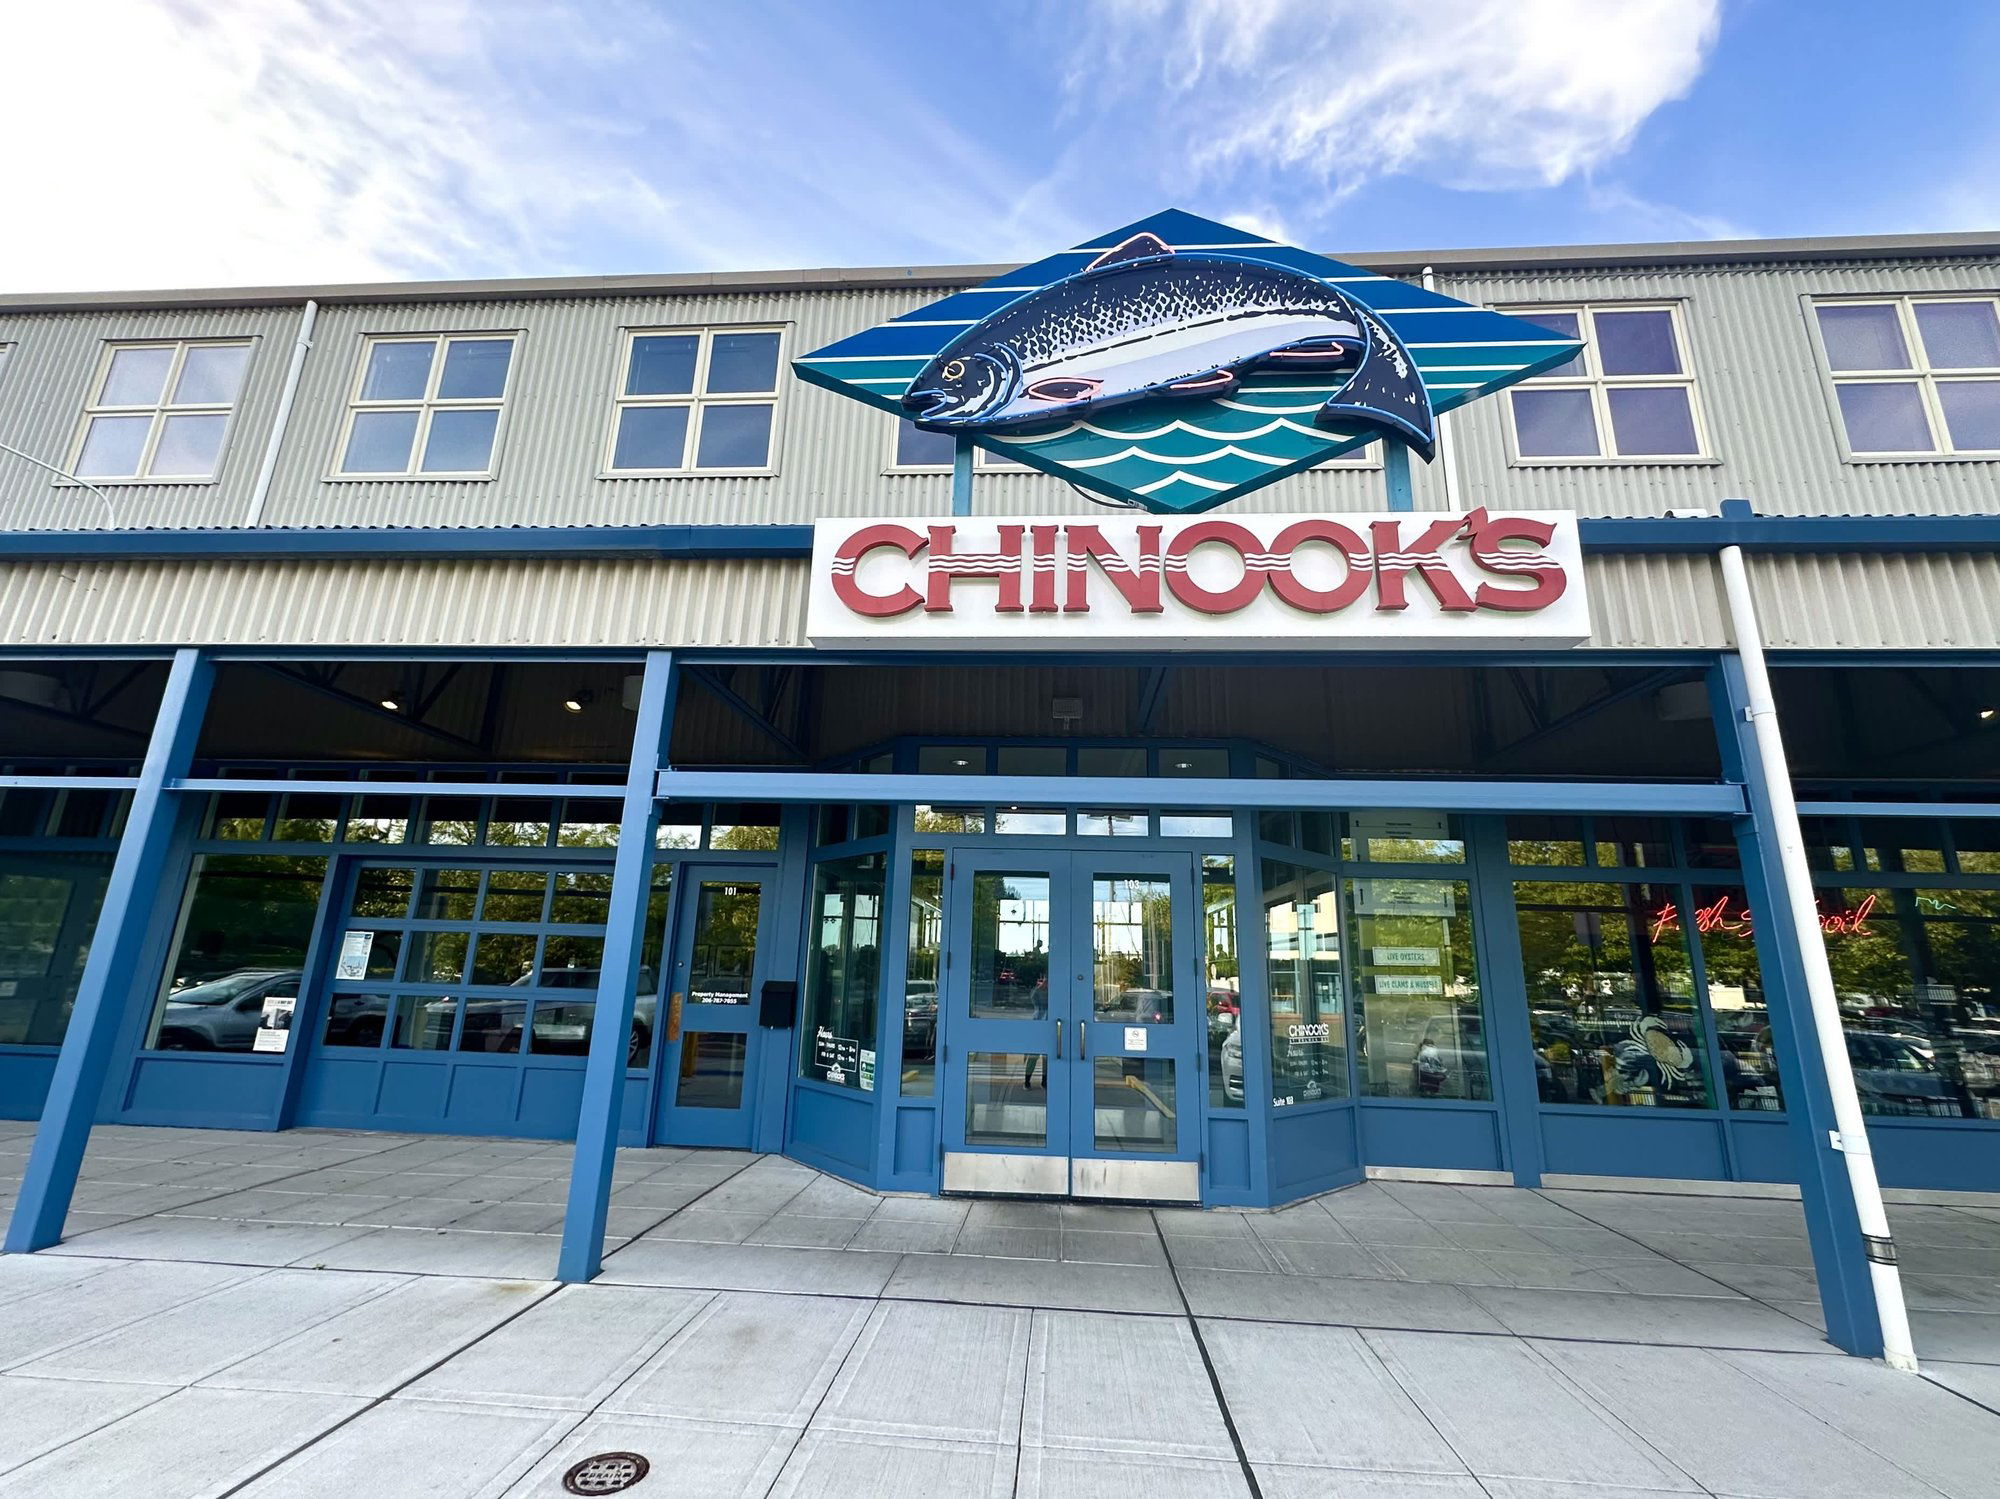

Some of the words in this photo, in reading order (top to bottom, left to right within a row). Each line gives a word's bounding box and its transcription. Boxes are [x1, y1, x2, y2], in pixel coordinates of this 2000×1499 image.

[830, 506, 1567, 615] CHINOOK'S
[1123, 879, 1140, 890] 103
[724, 886, 737, 896] 101
[1652, 895, 1743, 943] Fsh
[1387, 952, 1399, 961] LIVE
[1400, 952, 1425, 961] OYSTERS
[1289, 1024, 1329, 1036] CHINOOK'S
[1273, 1098, 1285, 1106] Suite
